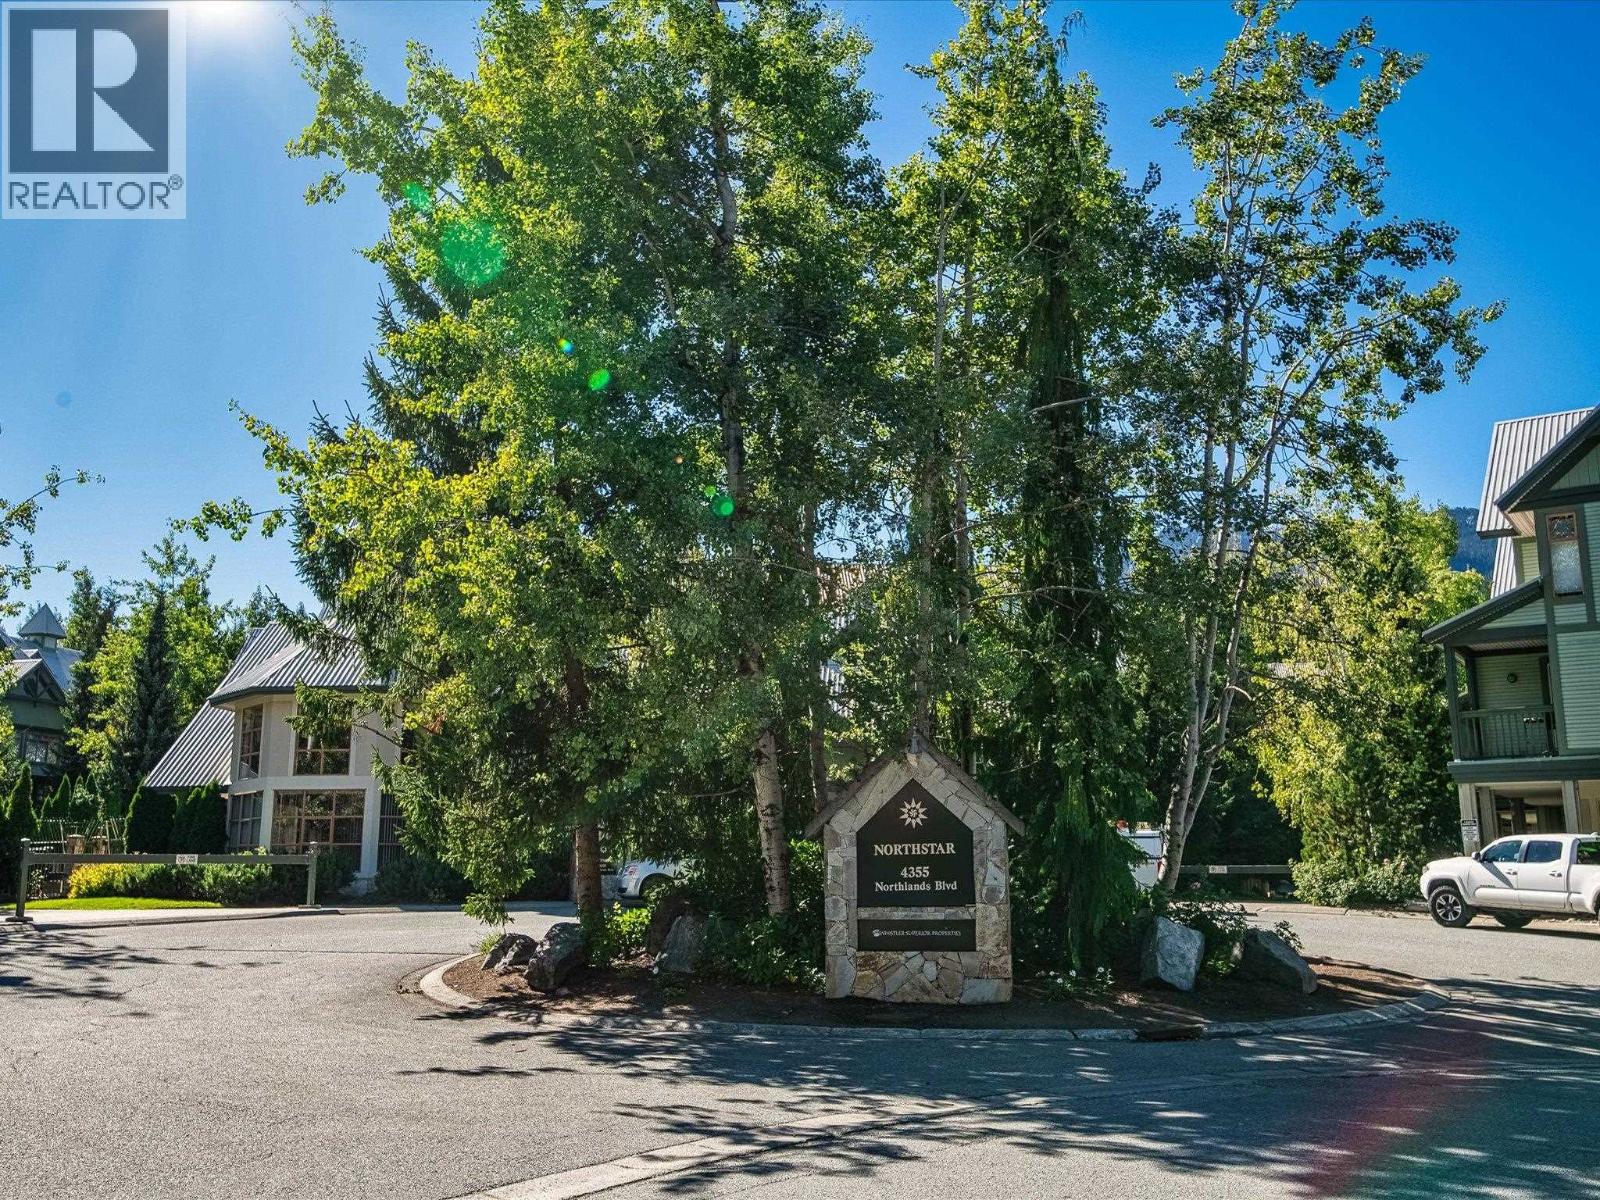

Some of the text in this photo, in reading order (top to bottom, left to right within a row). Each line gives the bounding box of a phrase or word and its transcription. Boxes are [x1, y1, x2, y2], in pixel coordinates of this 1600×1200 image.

[873, 842, 956, 855] NORTHSTAR
[900, 866, 930, 878] 4355
[875, 881, 957, 892] Northlands Blvd
